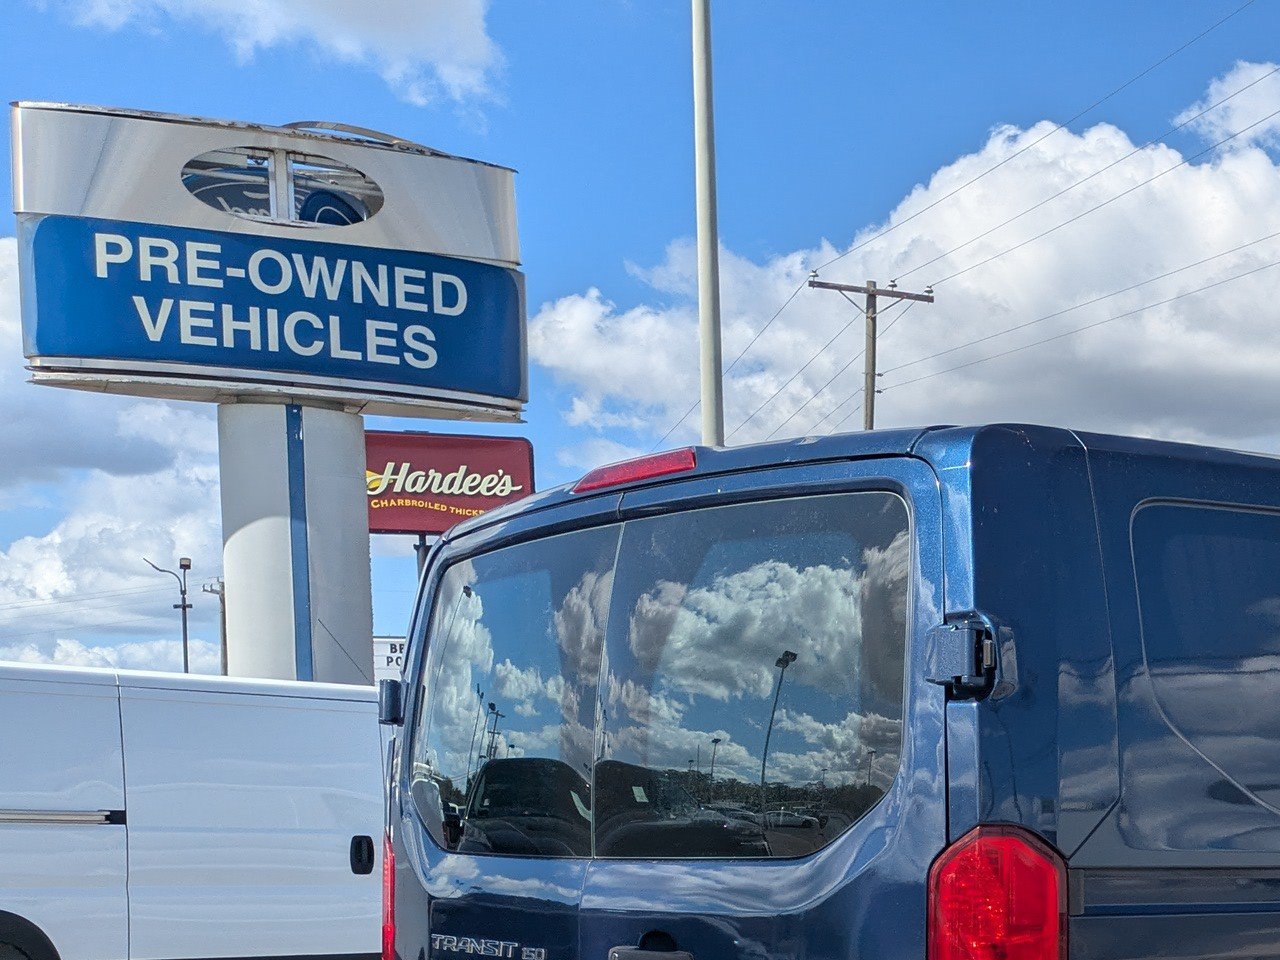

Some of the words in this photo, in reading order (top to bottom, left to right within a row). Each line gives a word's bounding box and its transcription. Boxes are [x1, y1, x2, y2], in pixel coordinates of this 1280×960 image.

[95, 232, 468, 317] PRE-OWNED
[132, 295, 438, 370] VEHICLES
[367, 461, 523, 497] Hardee's
[370, 499, 447, 512] CHARBROILED
[430, 933, 519, 958] TRANSIT
